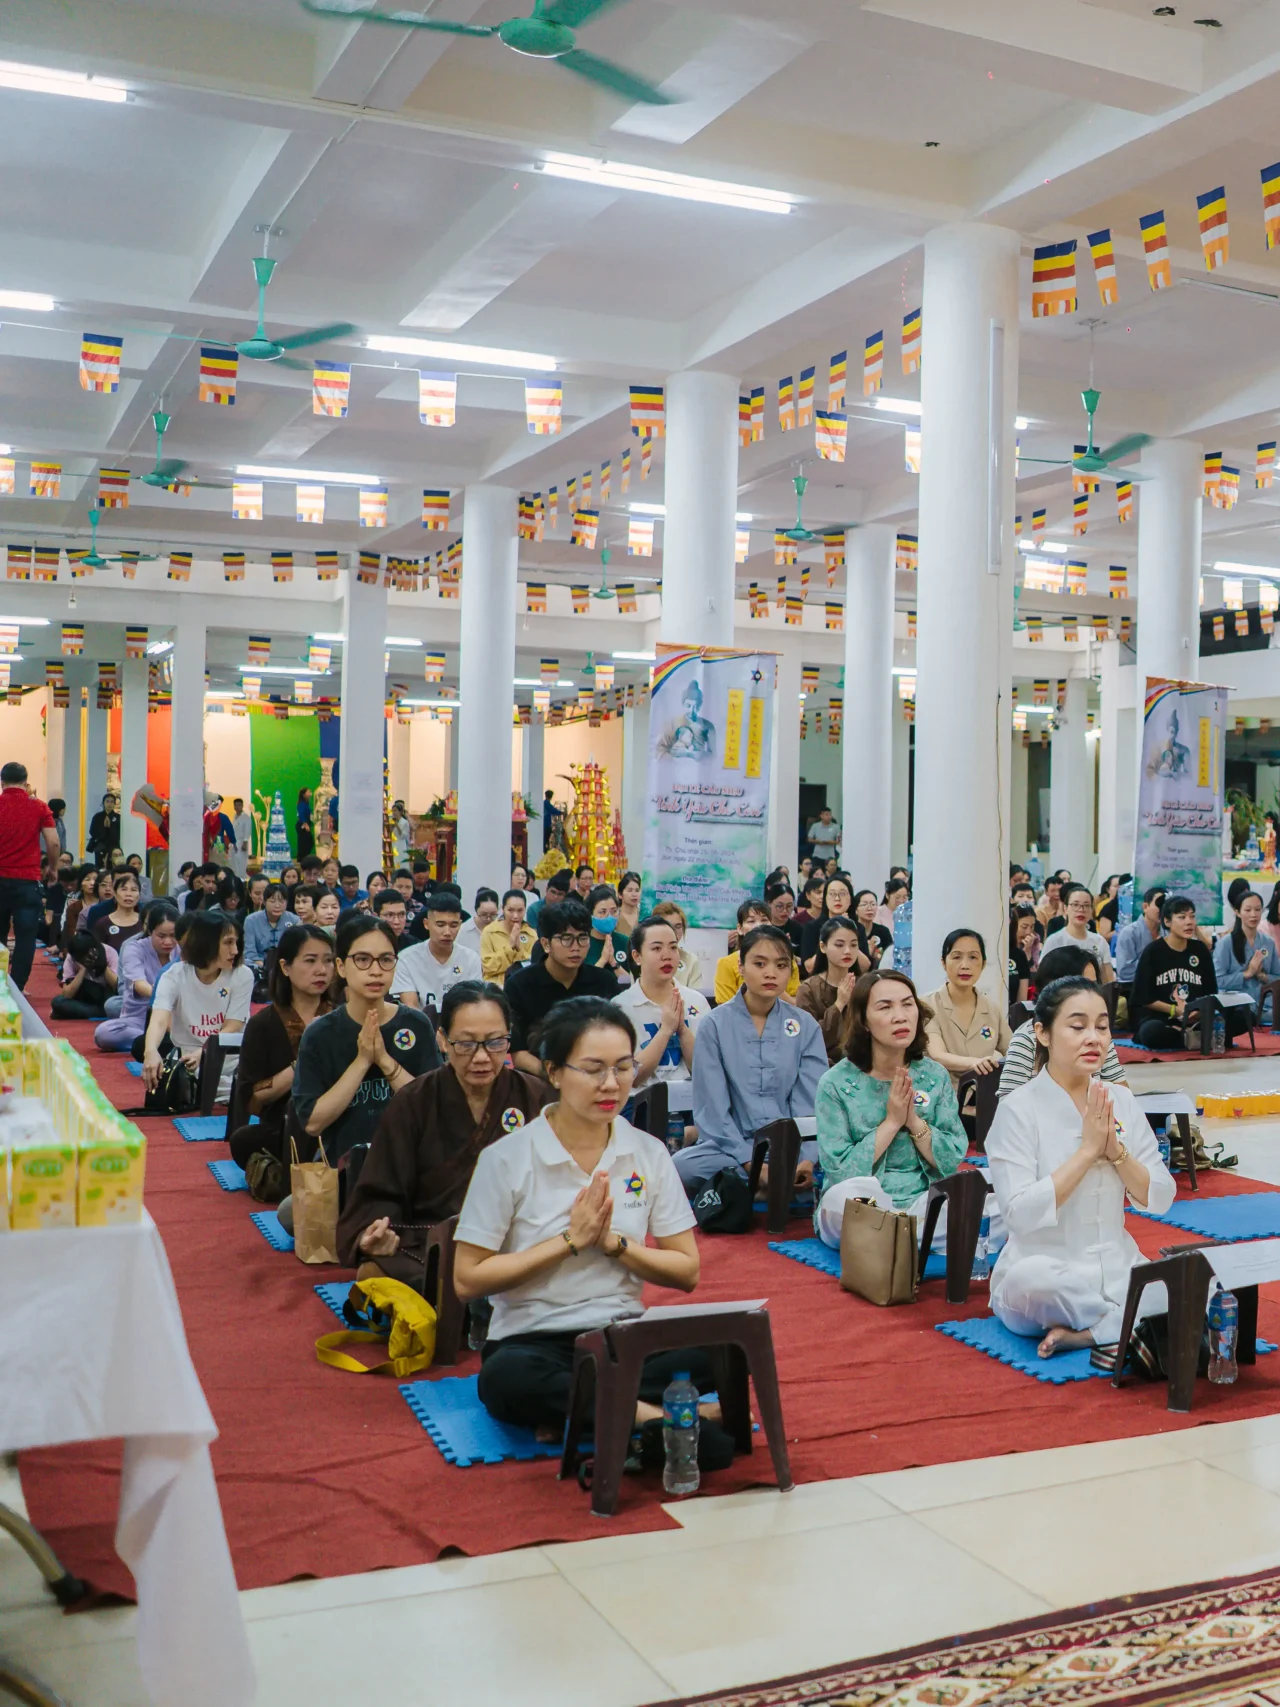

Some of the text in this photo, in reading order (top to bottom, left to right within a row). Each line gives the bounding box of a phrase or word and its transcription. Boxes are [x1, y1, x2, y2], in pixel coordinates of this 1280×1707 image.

[1156, 968, 1202, 986] NEW YORK
[201, 1012, 224, 1026] Hell
[189, 1025, 219, 1037] Tues
